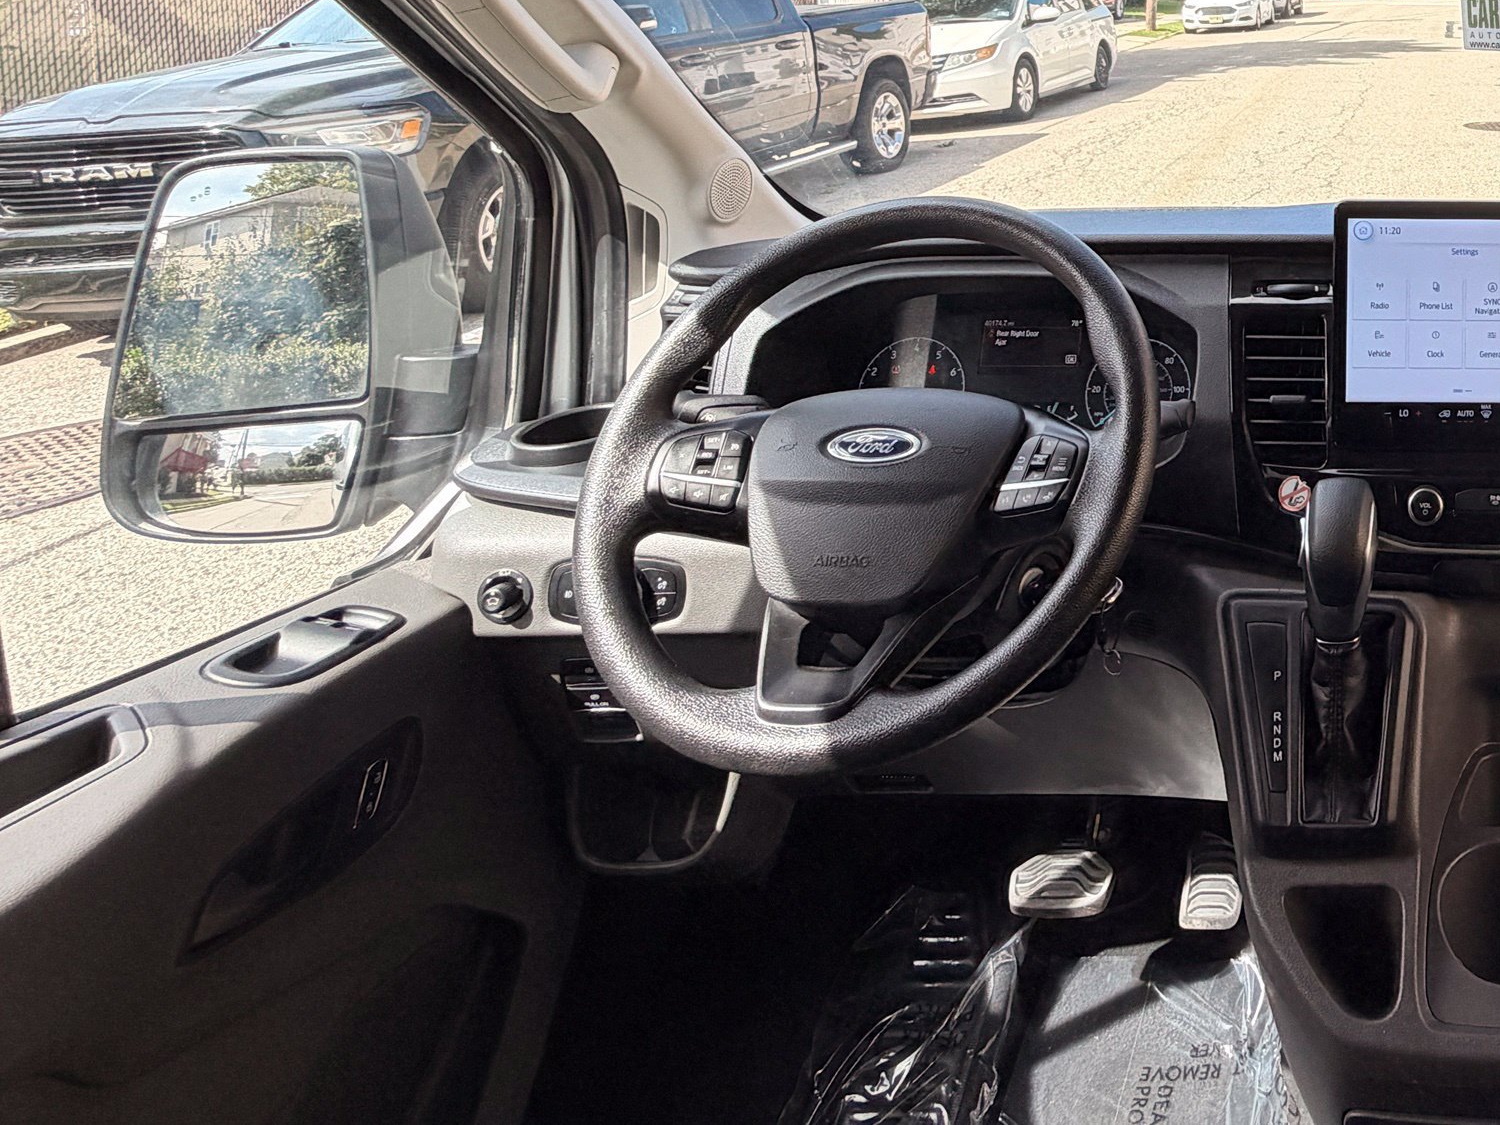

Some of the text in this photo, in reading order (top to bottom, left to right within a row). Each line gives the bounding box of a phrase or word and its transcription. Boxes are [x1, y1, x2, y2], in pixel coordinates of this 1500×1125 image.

[1470, 31, 1500, 39] AUTO
[40, 162, 154, 183] RAM
[1379, 226, 1401, 235] 11:20
[1451, 247, 1479, 257] Settings
[1370, 301, 1390, 310] Radio
[1419, 302, 1453, 310] Phone List
[1010, 330, 1025, 338] Right
[890, 350, 897, 359] 3
[936, 350, 942, 360] 5
[1367, 349, 1392, 357] Vehicle
[1426, 350, 1445, 358] Clock
[1164, 357, 1175, 365] 80
[870, 367, 878, 376] 2
[950, 367, 957, 376] 6
[1399, 409, 1409, 417] LO
[1456, 409, 1475, 417] AUTO
[848, 435, 898, 453] Ford
[813, 555, 870, 568] AIRBAG
[1273, 670, 1282, 681] P
[1273, 711, 1282, 722] R
[1273, 724, 1282, 735] N
[1273, 738, 1281, 748] D
[1273, 751, 1283, 762] M
[1139, 1063, 1222, 1082] REMOVE
